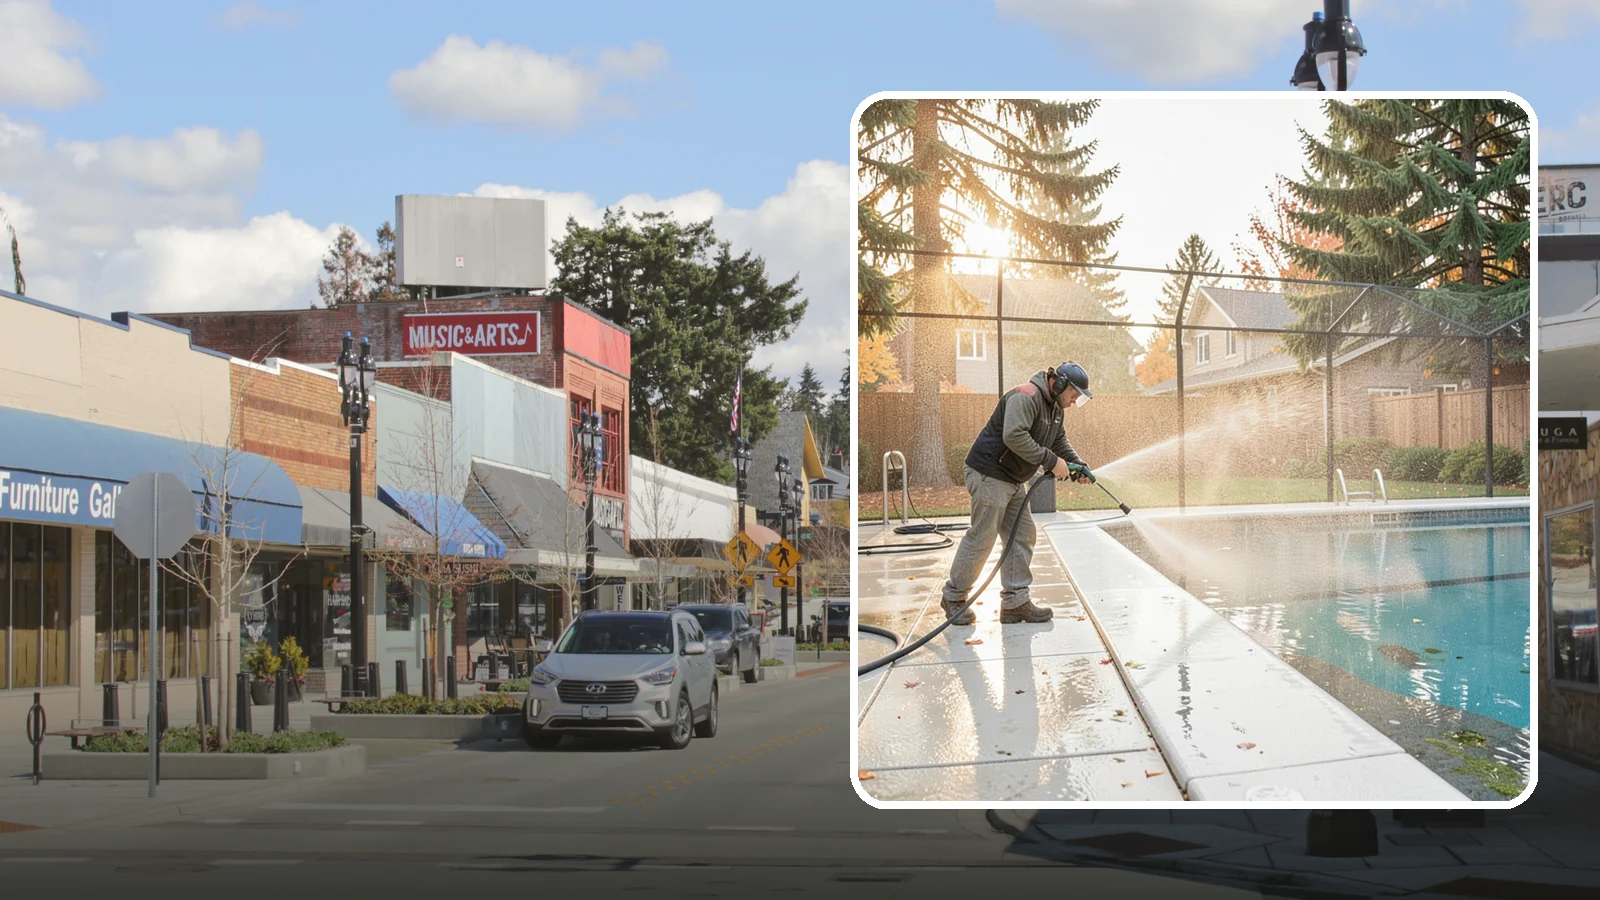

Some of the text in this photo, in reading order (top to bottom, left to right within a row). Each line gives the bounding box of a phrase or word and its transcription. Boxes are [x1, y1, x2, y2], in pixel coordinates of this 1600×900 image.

[0, 471, 122, 519] Furniture Gal
[453, 563, 479, 574] SUSHI
